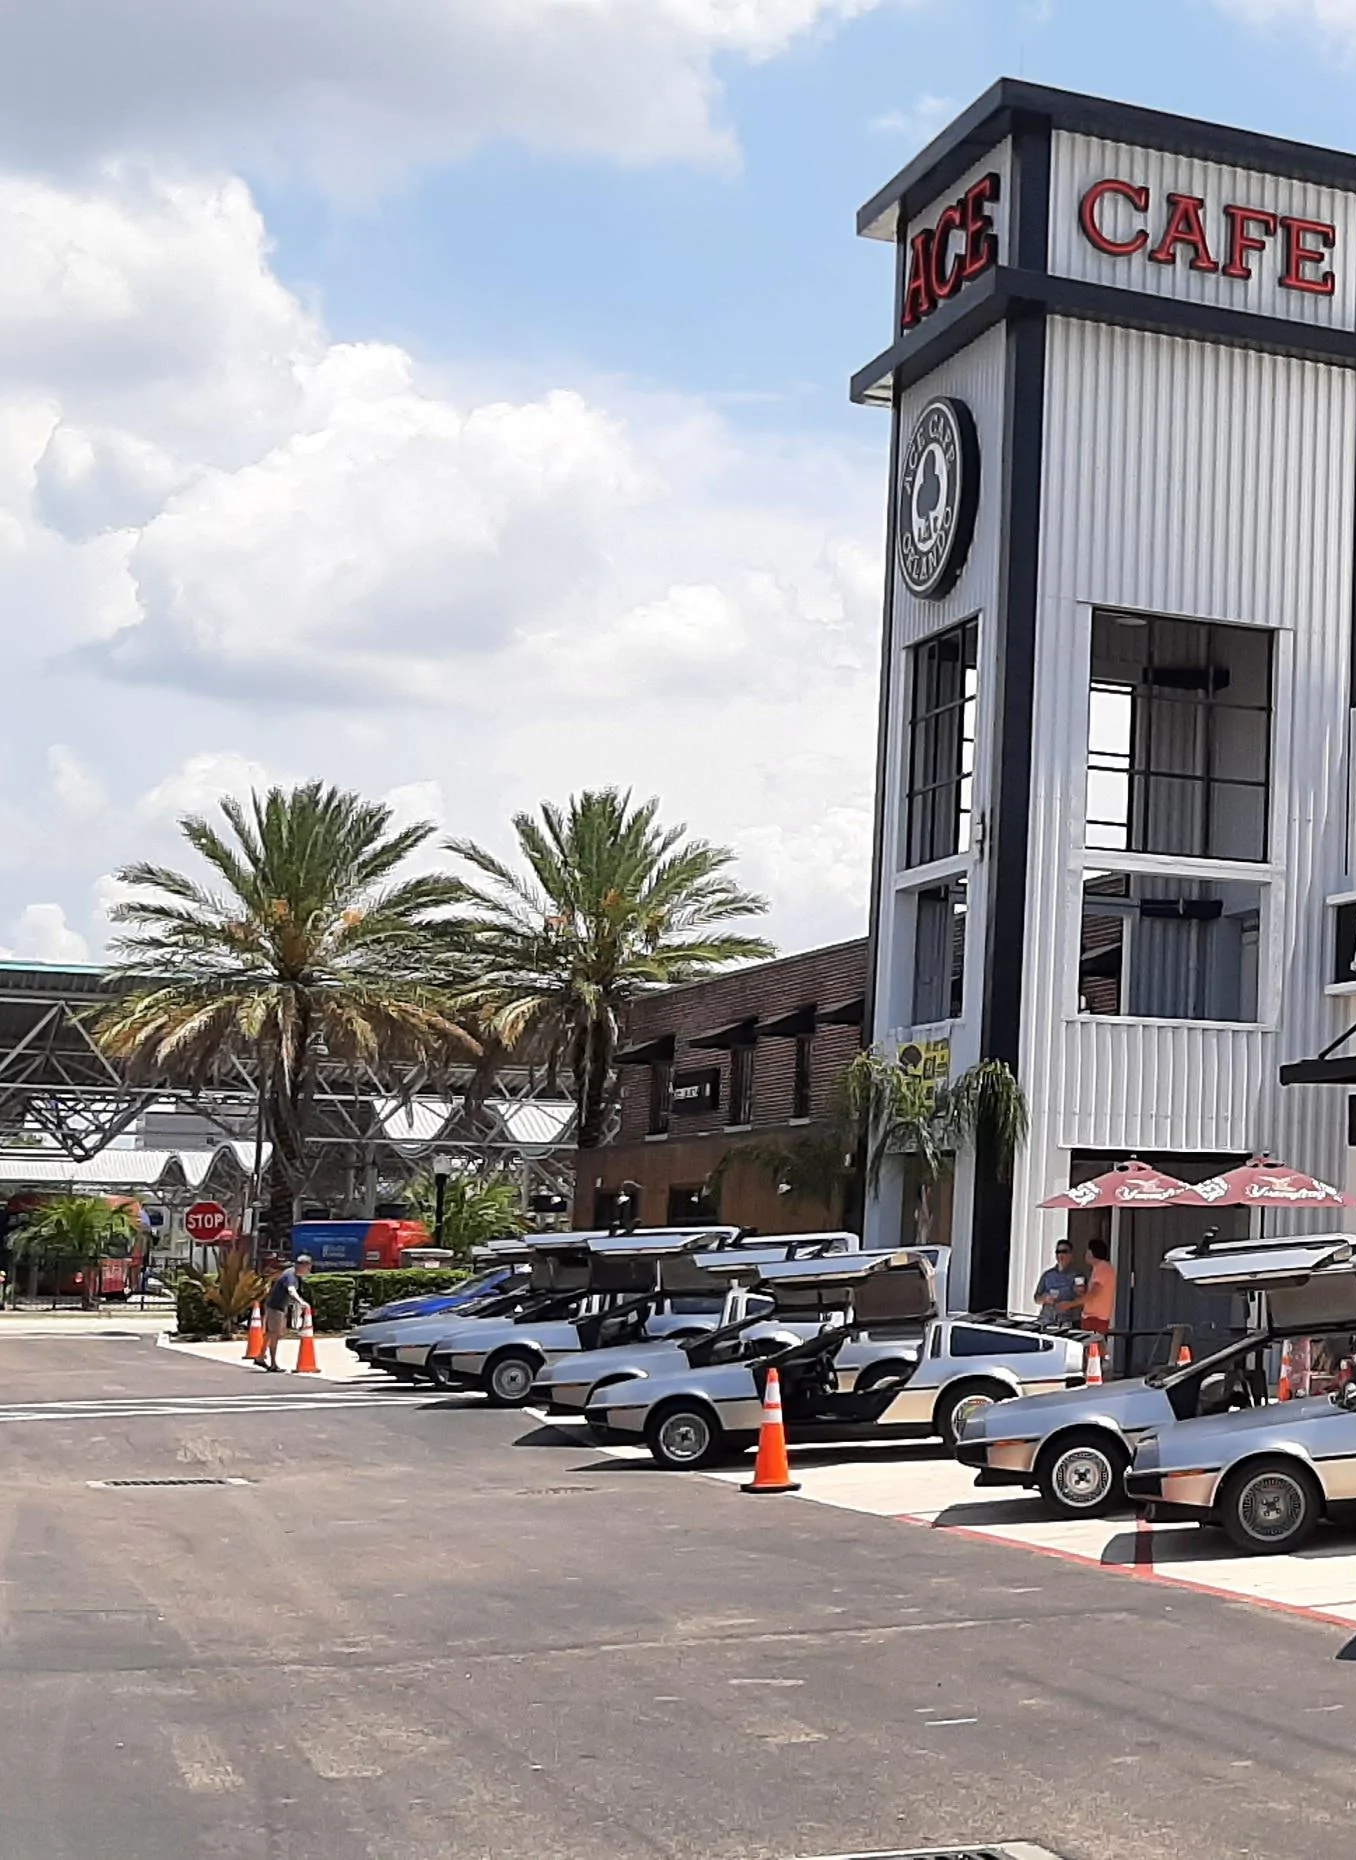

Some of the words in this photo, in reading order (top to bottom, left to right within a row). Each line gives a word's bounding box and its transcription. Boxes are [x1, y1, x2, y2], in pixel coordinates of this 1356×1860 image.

[903, 172, 1000, 328] ACE
[1079, 179, 1336, 295] CAFE
[903, 506, 951, 580] ORLANDO
[187, 1213, 224, 1229] STOP
